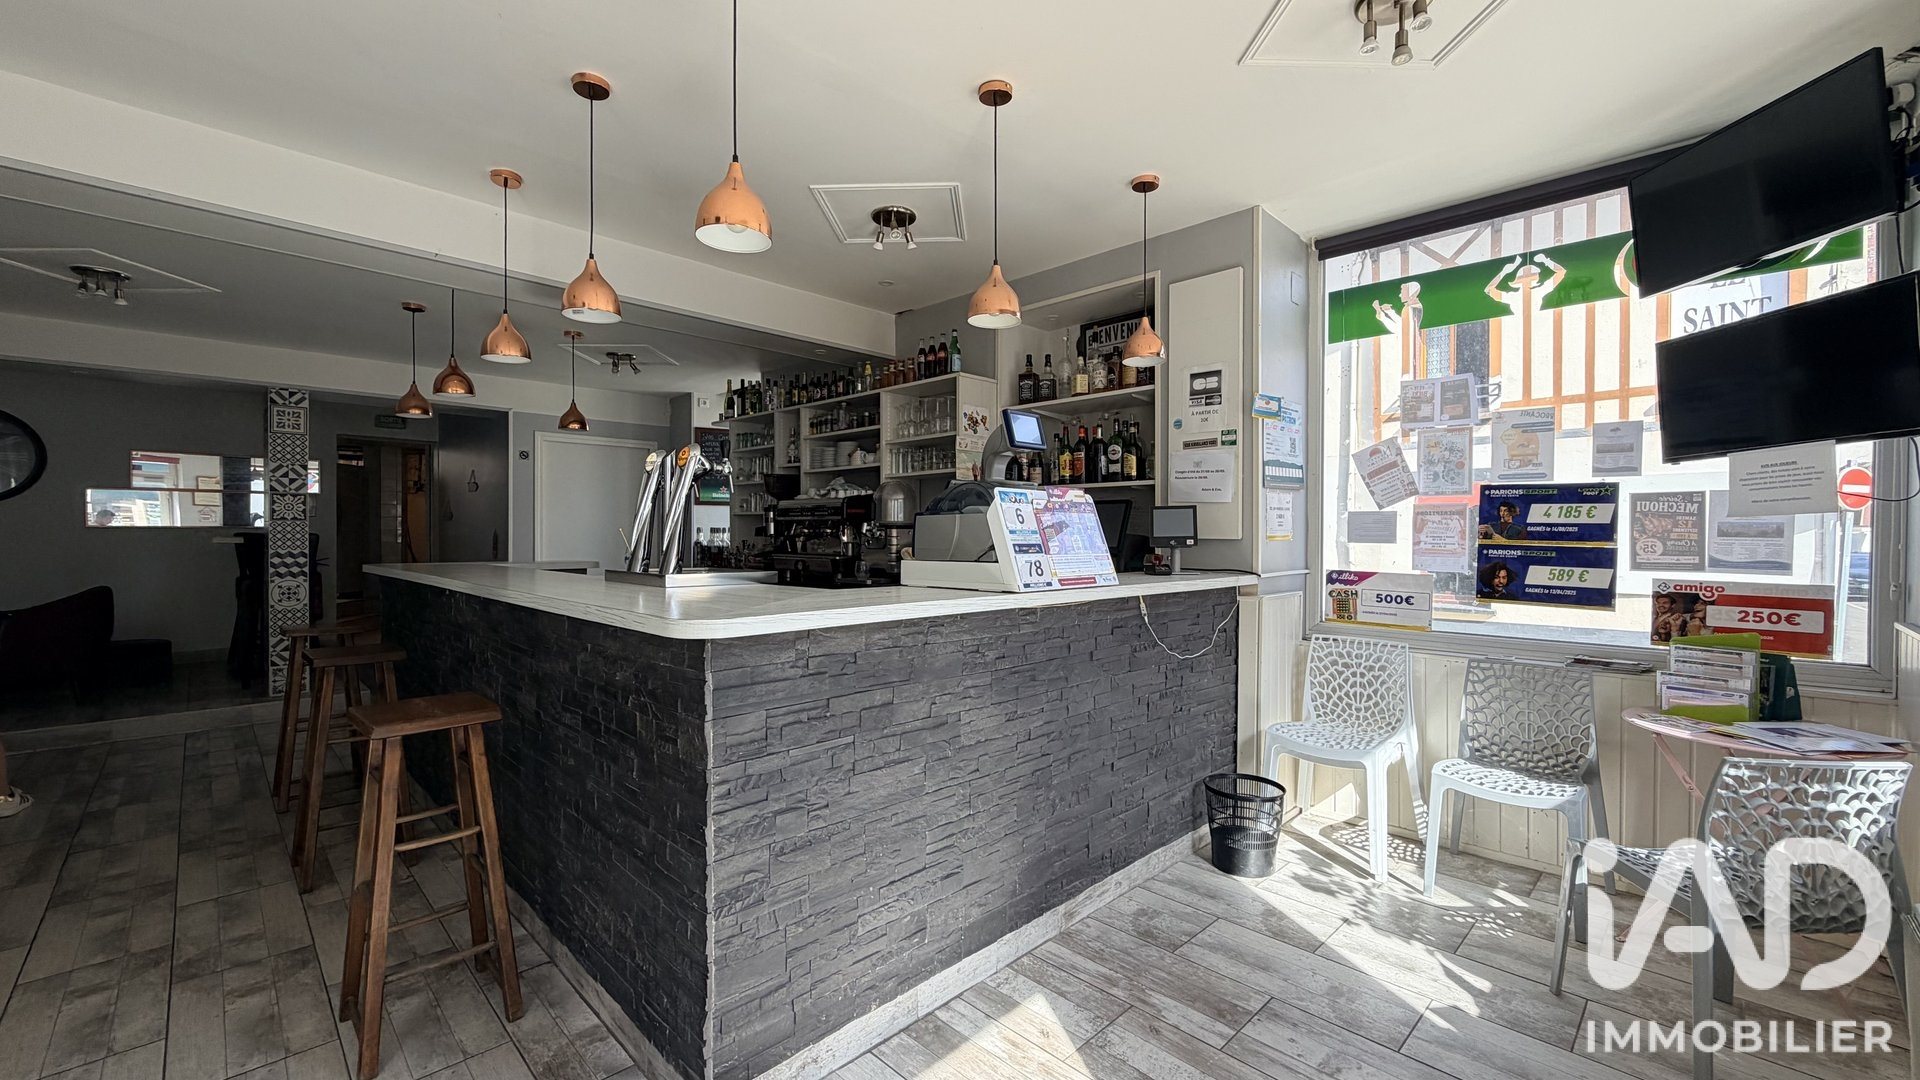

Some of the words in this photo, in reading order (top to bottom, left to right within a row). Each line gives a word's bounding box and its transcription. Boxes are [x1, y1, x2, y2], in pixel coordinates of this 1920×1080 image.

[1684, 296, 1772, 333] SAINT
[1015, 508, 1025, 524] 6
[1543, 506, 1552, 518] 4
[1557, 505, 1583, 518] 185
[1586, 506, 1597, 518] €
[1025, 560, 1044, 577] 78
[1548, 568, 1574, 581] 589
[1578, 570, 1589, 582] €
[1328, 590, 1358, 598] CASH
[1673, 583, 1726, 598] amigo
[1376, 593, 1414, 605] 500€
[1737, 610, 1802, 626] 250€
